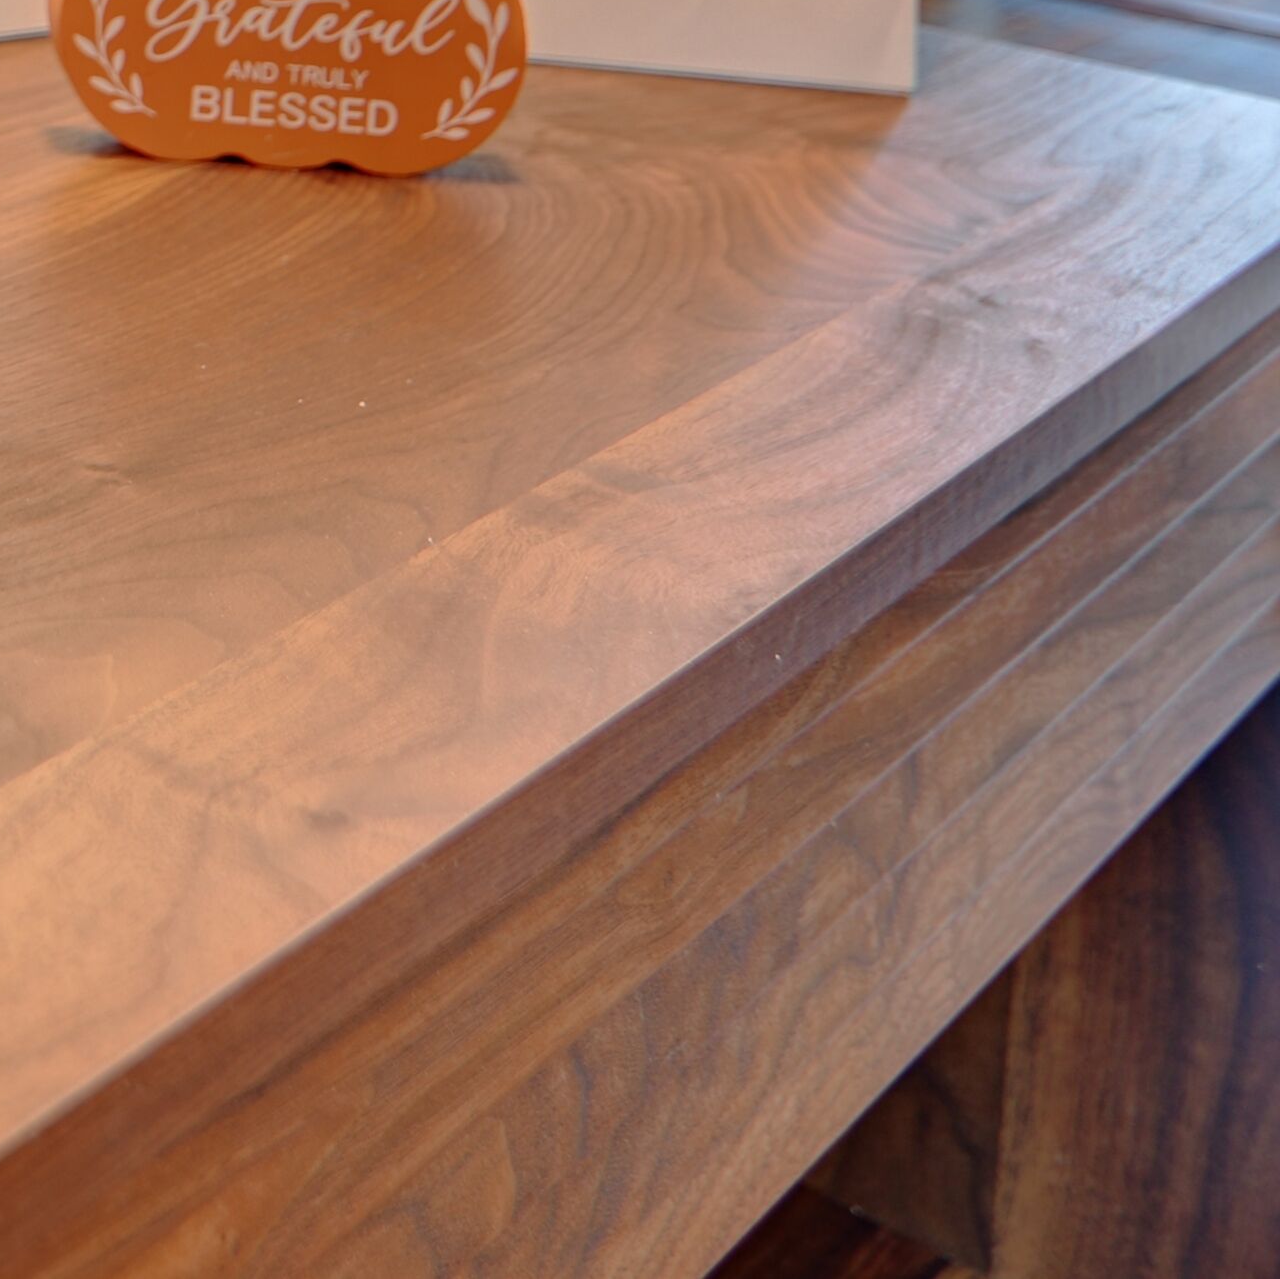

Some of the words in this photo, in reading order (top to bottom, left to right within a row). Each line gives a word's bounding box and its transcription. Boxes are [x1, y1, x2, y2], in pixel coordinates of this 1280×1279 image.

[224, 60, 279, 84] AND
[287, 63, 370, 91] TRULY
[189, 83, 398, 137] BLESSED
